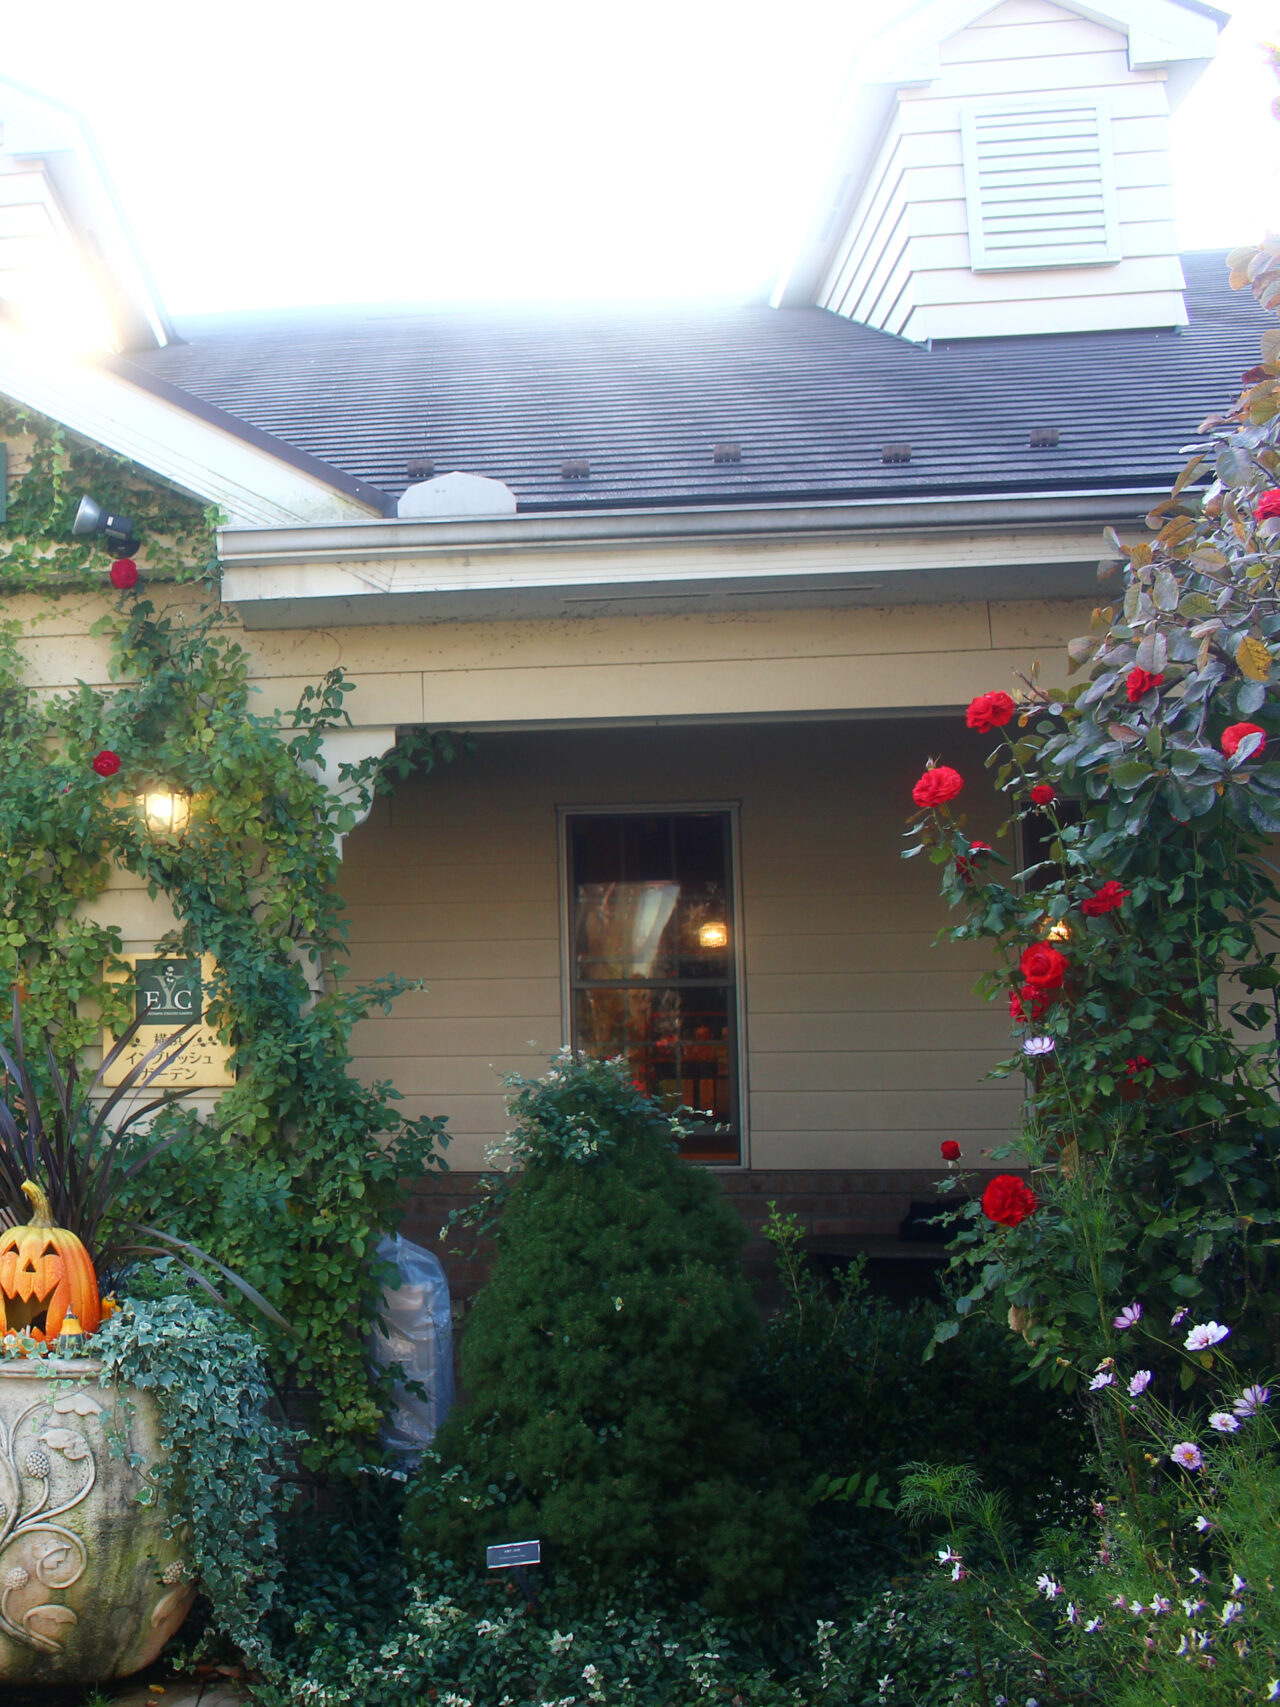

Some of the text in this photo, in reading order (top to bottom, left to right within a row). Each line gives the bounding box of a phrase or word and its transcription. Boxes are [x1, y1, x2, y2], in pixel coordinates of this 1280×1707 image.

[126, 1052, 213, 1065] イグッシュ
